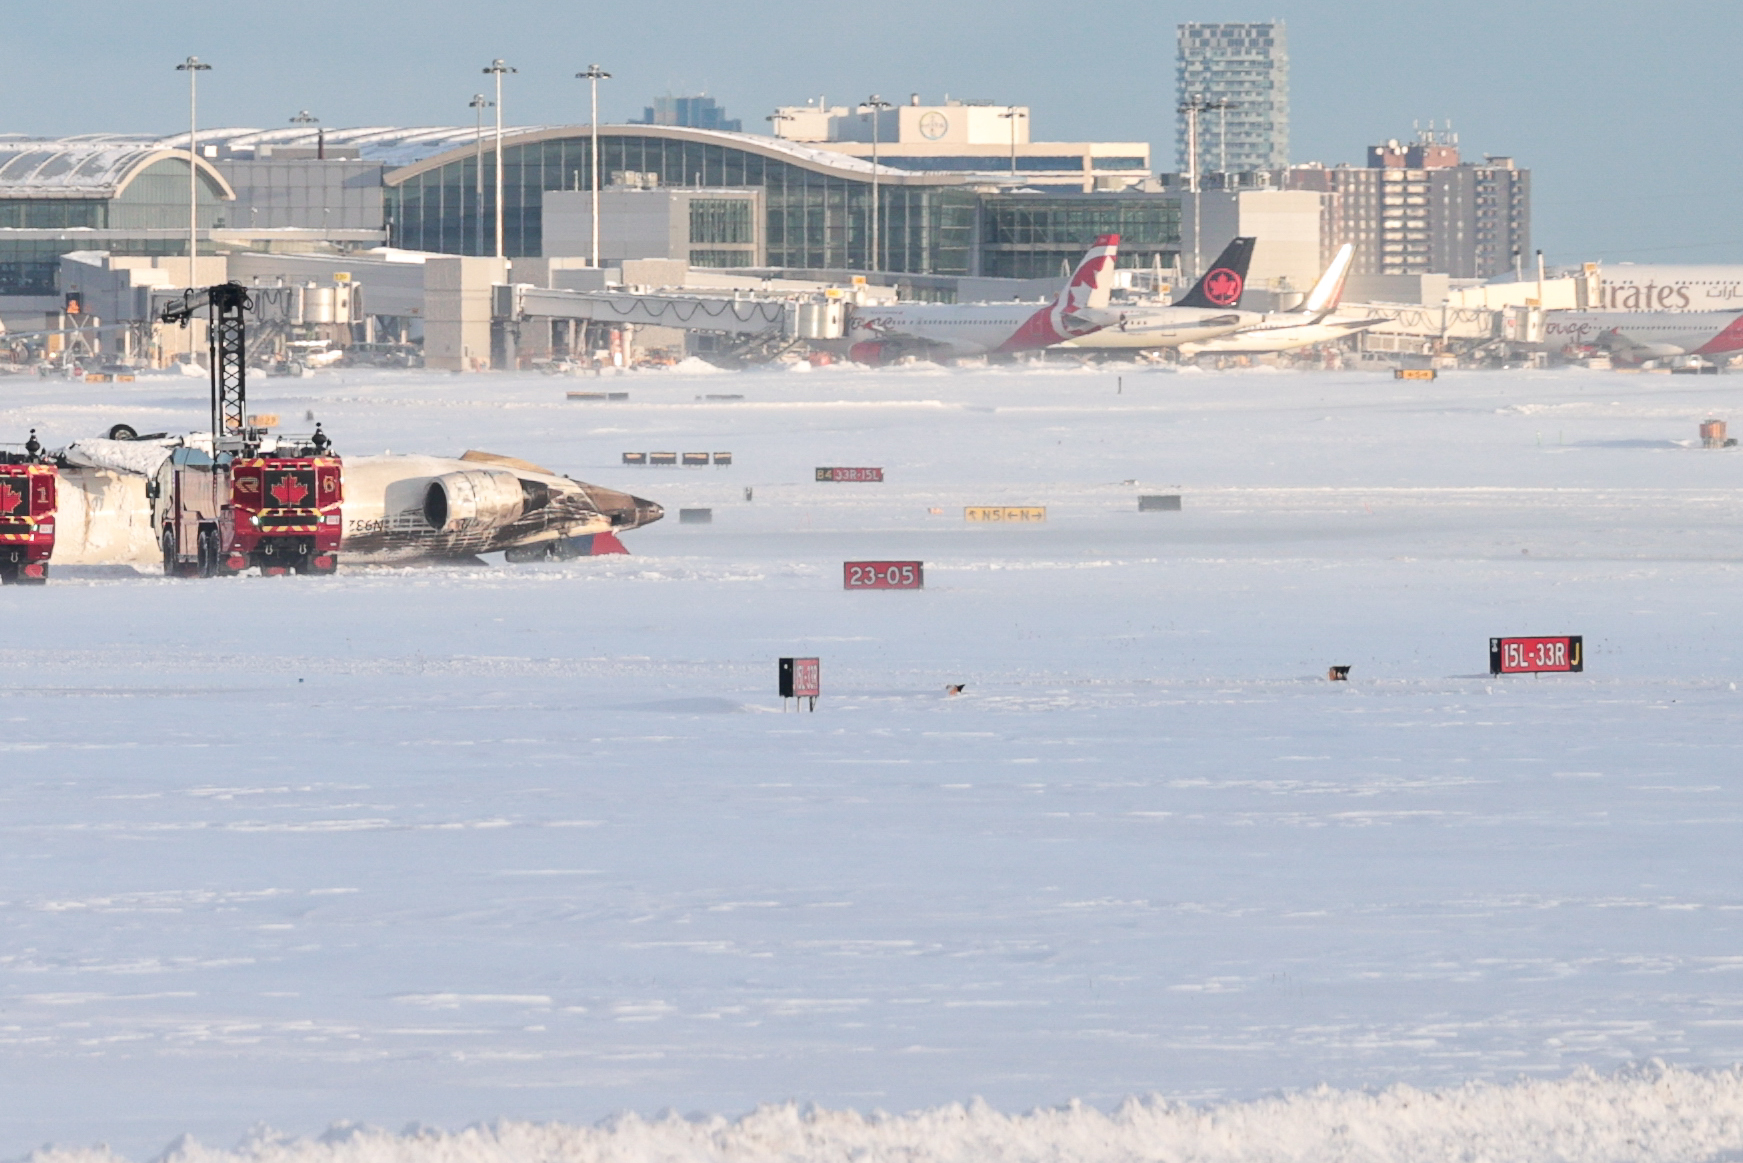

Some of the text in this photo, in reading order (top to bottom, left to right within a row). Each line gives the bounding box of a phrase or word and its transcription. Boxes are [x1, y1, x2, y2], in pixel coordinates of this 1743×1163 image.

[1600, 280, 1691, 309] irates
[1546, 322, 1591, 342] ouge
[323, 475, 336, 493] 6
[37, 486, 49, 503] 1
[850, 566, 915, 586] 23-05
[1504, 643, 1566, 668] 15L-33R
[1570, 642, 1580, 666] J
